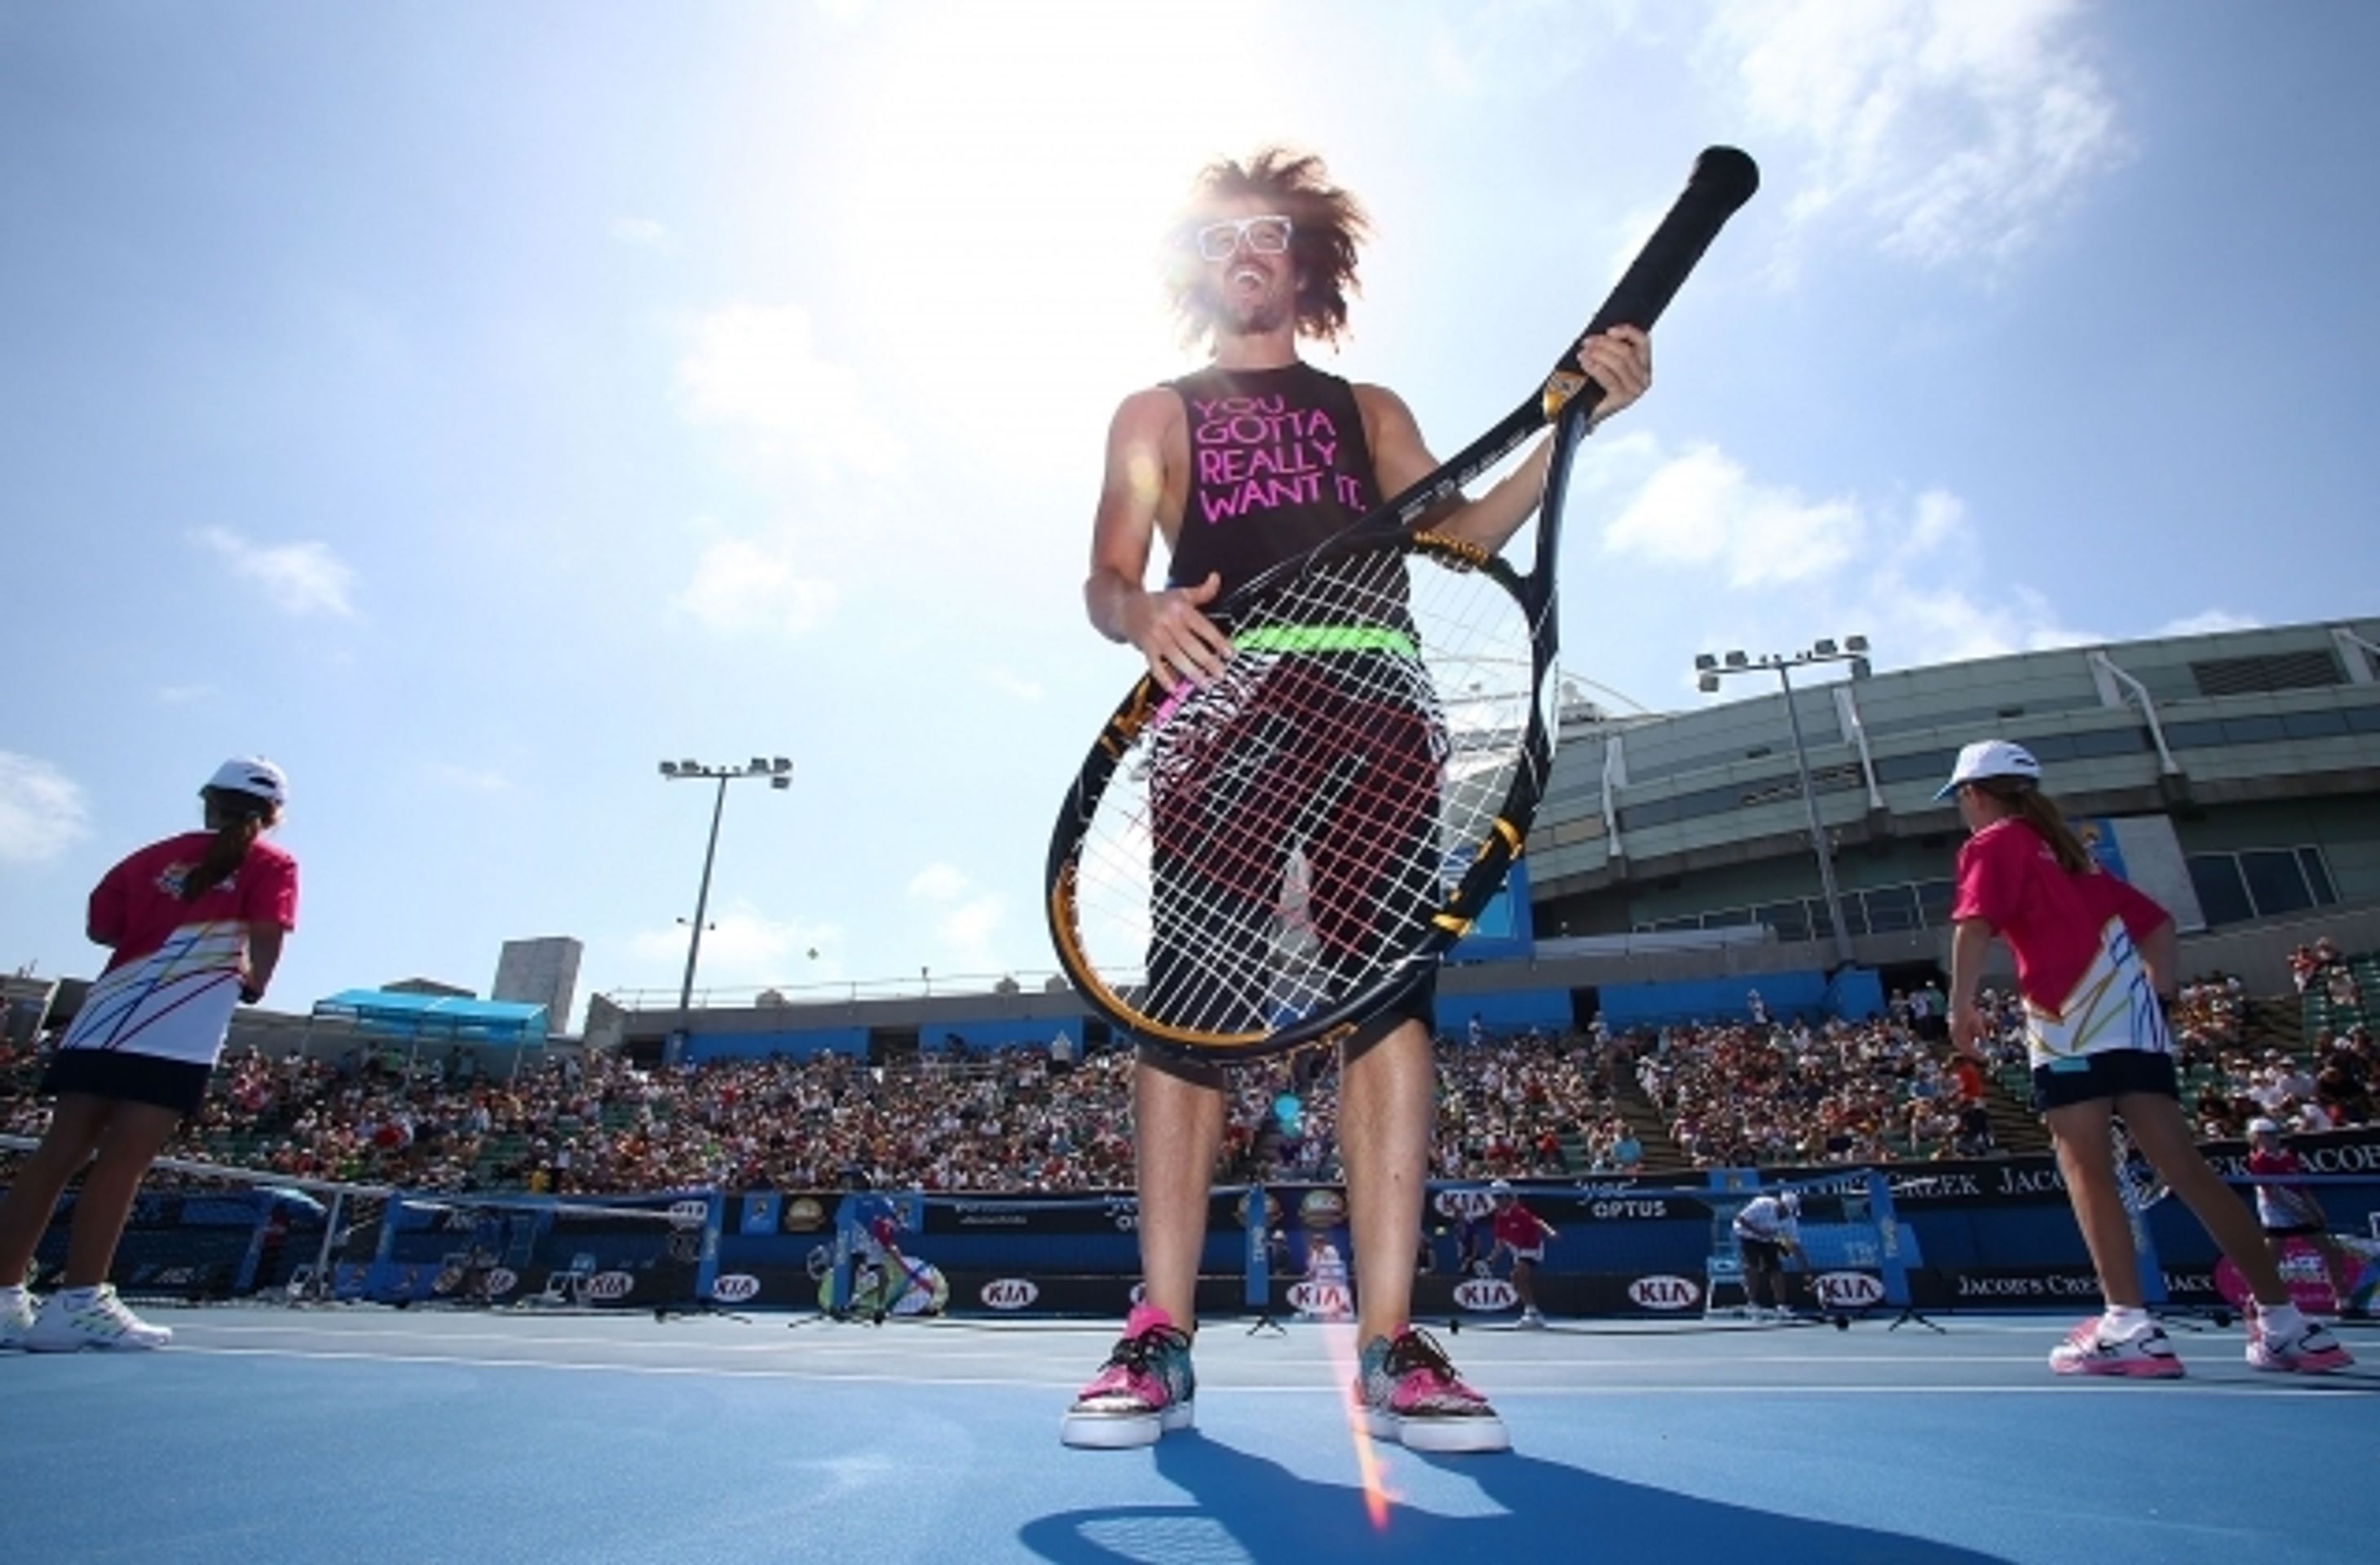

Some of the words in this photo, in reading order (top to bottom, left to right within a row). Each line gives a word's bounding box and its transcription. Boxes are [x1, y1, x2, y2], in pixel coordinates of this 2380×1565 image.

[1193, 395, 1285, 417] YOU
[1196, 410, 1337, 444] GOTTA
[1199, 441, 1337, 485] REALLY
[1199, 472, 1322, 523] WANT
[2298, 1144, 2380, 1174] ACOB
[1592, 1200, 1667, 1219] OPTUS
[987, 1284, 1030, 1303] KIA
[1467, 1285, 1510, 1303] KIA
[1638, 1281, 1691, 1301] KIA
[1821, 1277, 1875, 1298] KIA
